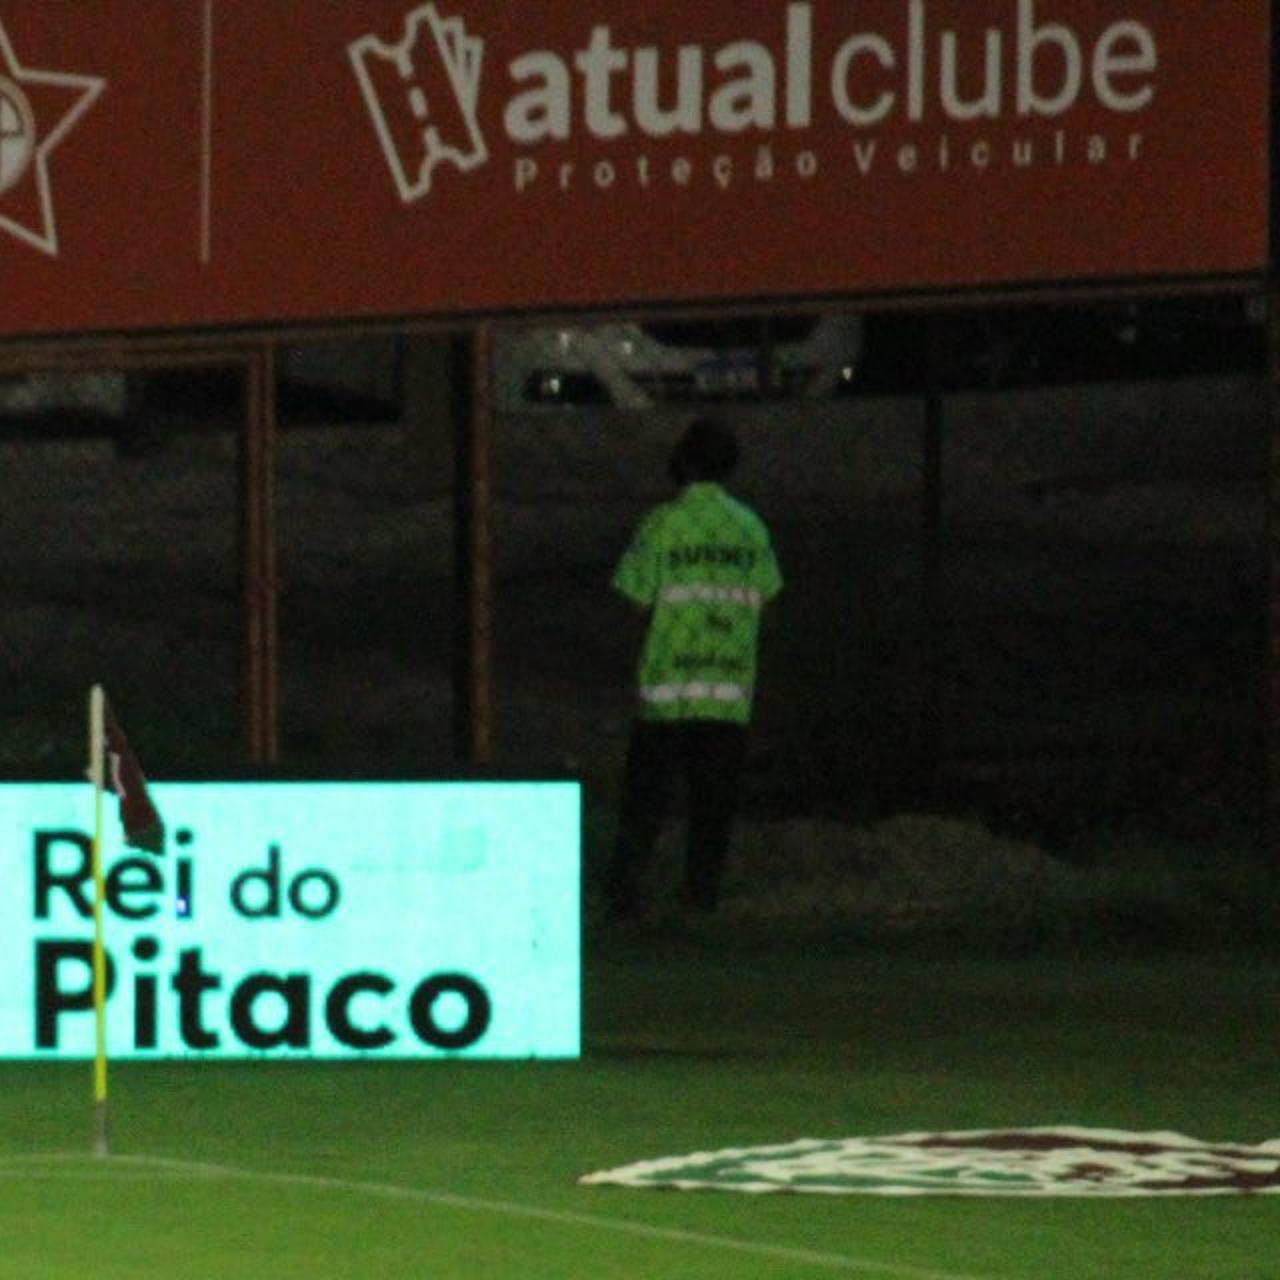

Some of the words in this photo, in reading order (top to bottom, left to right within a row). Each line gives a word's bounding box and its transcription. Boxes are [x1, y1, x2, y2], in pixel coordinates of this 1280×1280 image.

[514, 143, 818, 192] Proteção
[853, 132, 1143, 172] Veicular
[34, 828, 193, 919] Rei
[230, 844, 340, 918] do
[35, 937, 492, 1050] Pitaco
